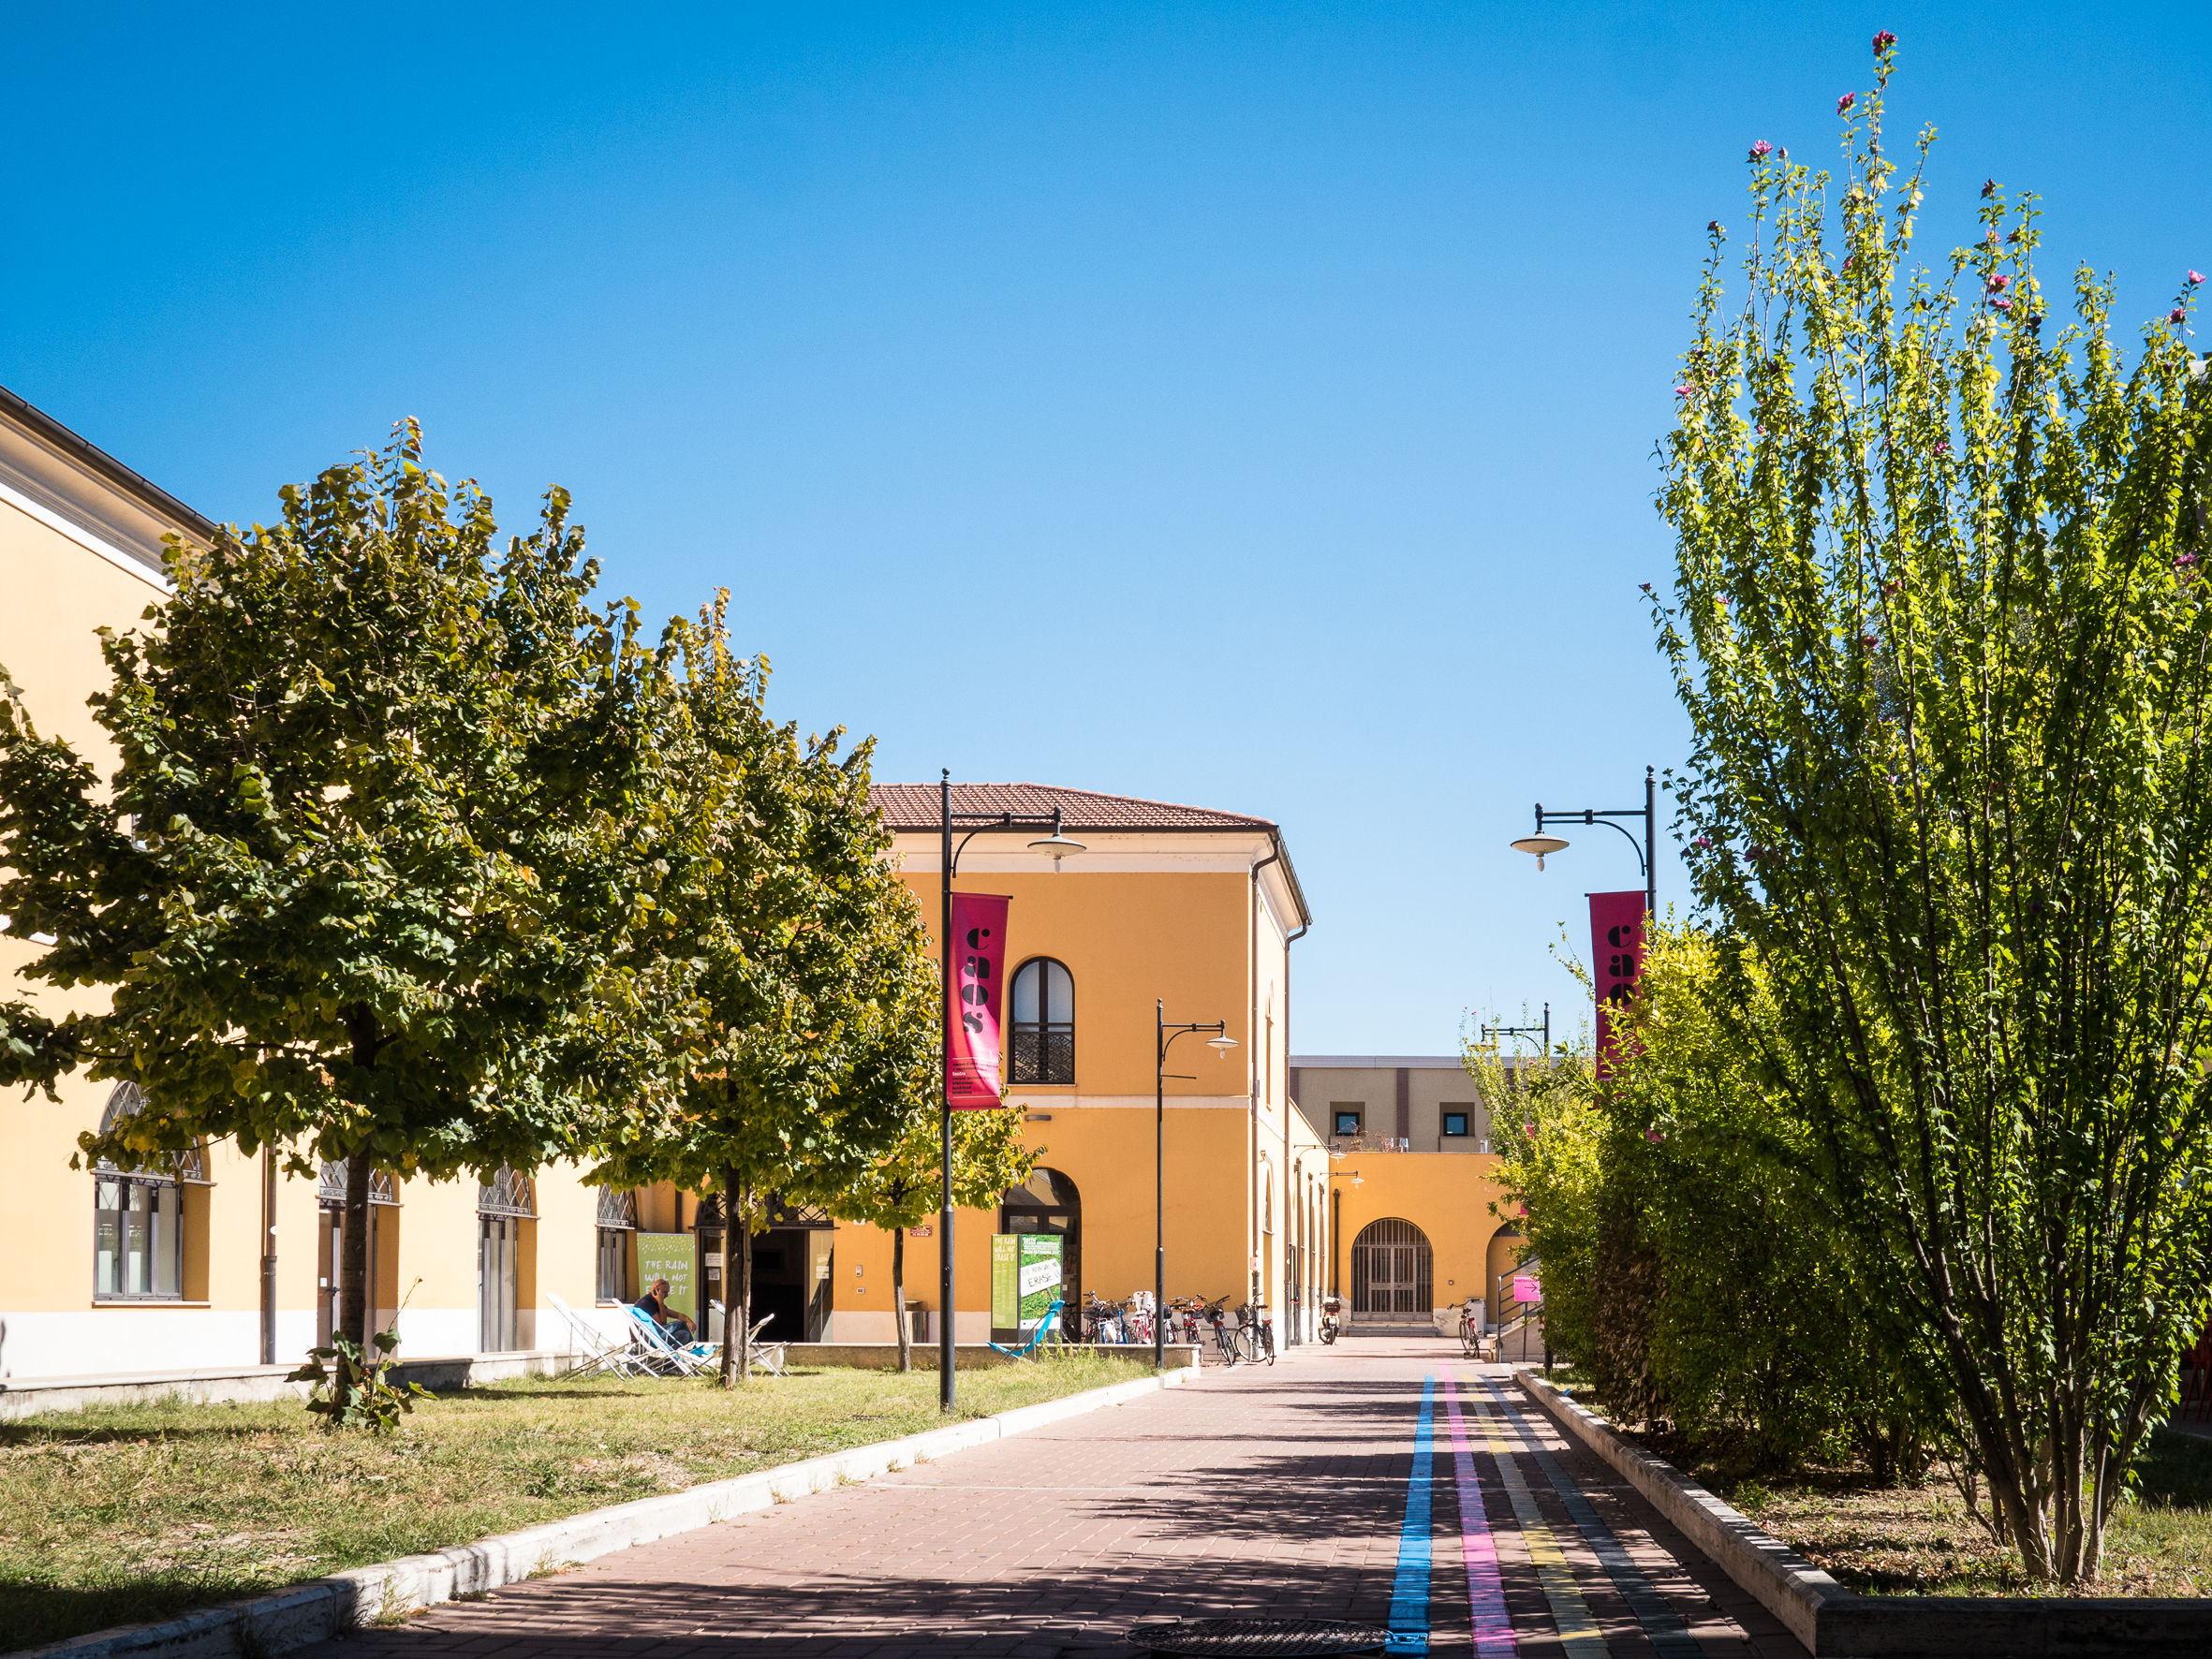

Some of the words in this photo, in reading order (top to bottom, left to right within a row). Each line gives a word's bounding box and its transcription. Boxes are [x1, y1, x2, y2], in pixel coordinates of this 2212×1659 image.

[644, 1260, 662, 1270] THE
[665, 1259, 688, 1270] RAIN
[671, 1272, 689, 1282] NOT
[678, 1285, 688, 1296] IT
